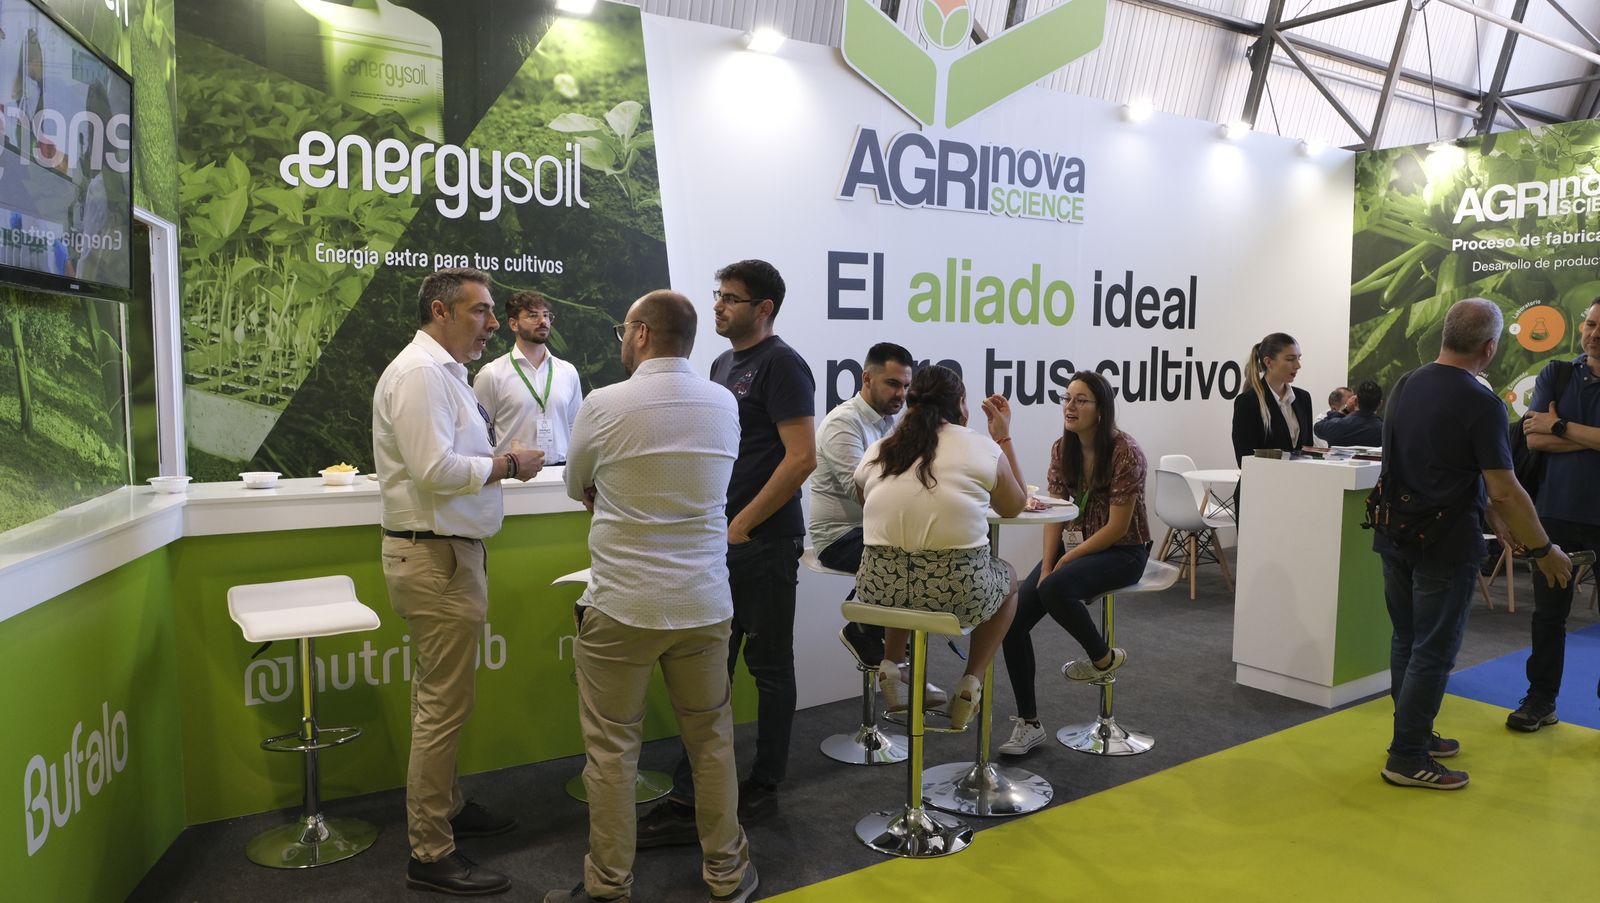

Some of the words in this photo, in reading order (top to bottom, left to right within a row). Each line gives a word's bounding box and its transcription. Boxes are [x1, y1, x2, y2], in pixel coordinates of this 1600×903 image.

[343, 58, 428, 88] energysoil
[279, 130, 590, 221] energysoil
[840, 127, 1086, 212] AGRInova
[990, 186, 1085, 222] SCIENCE
[315, 242, 379, 270] Energía
[385, 249, 428, 267] extra
[434, 253, 469, 272] para
[474, 252, 499, 271] tus
[504, 254, 564, 274] cultivos
[1452, 238, 1515, 251] Proceso
[1520, 234, 1540, 247] de
[1472, 259, 1531, 272] Desarrollo
[1534, 257, 1550, 268] de
[1554, 255, 1600, 270] produc
[828, 251, 884, 320] El
[908, 257, 1075, 327] aliado
[1093, 270, 1198, 330] ideal
[985, 348, 1075, 406] tus
[24, 701, 129, 857] Bufalo
